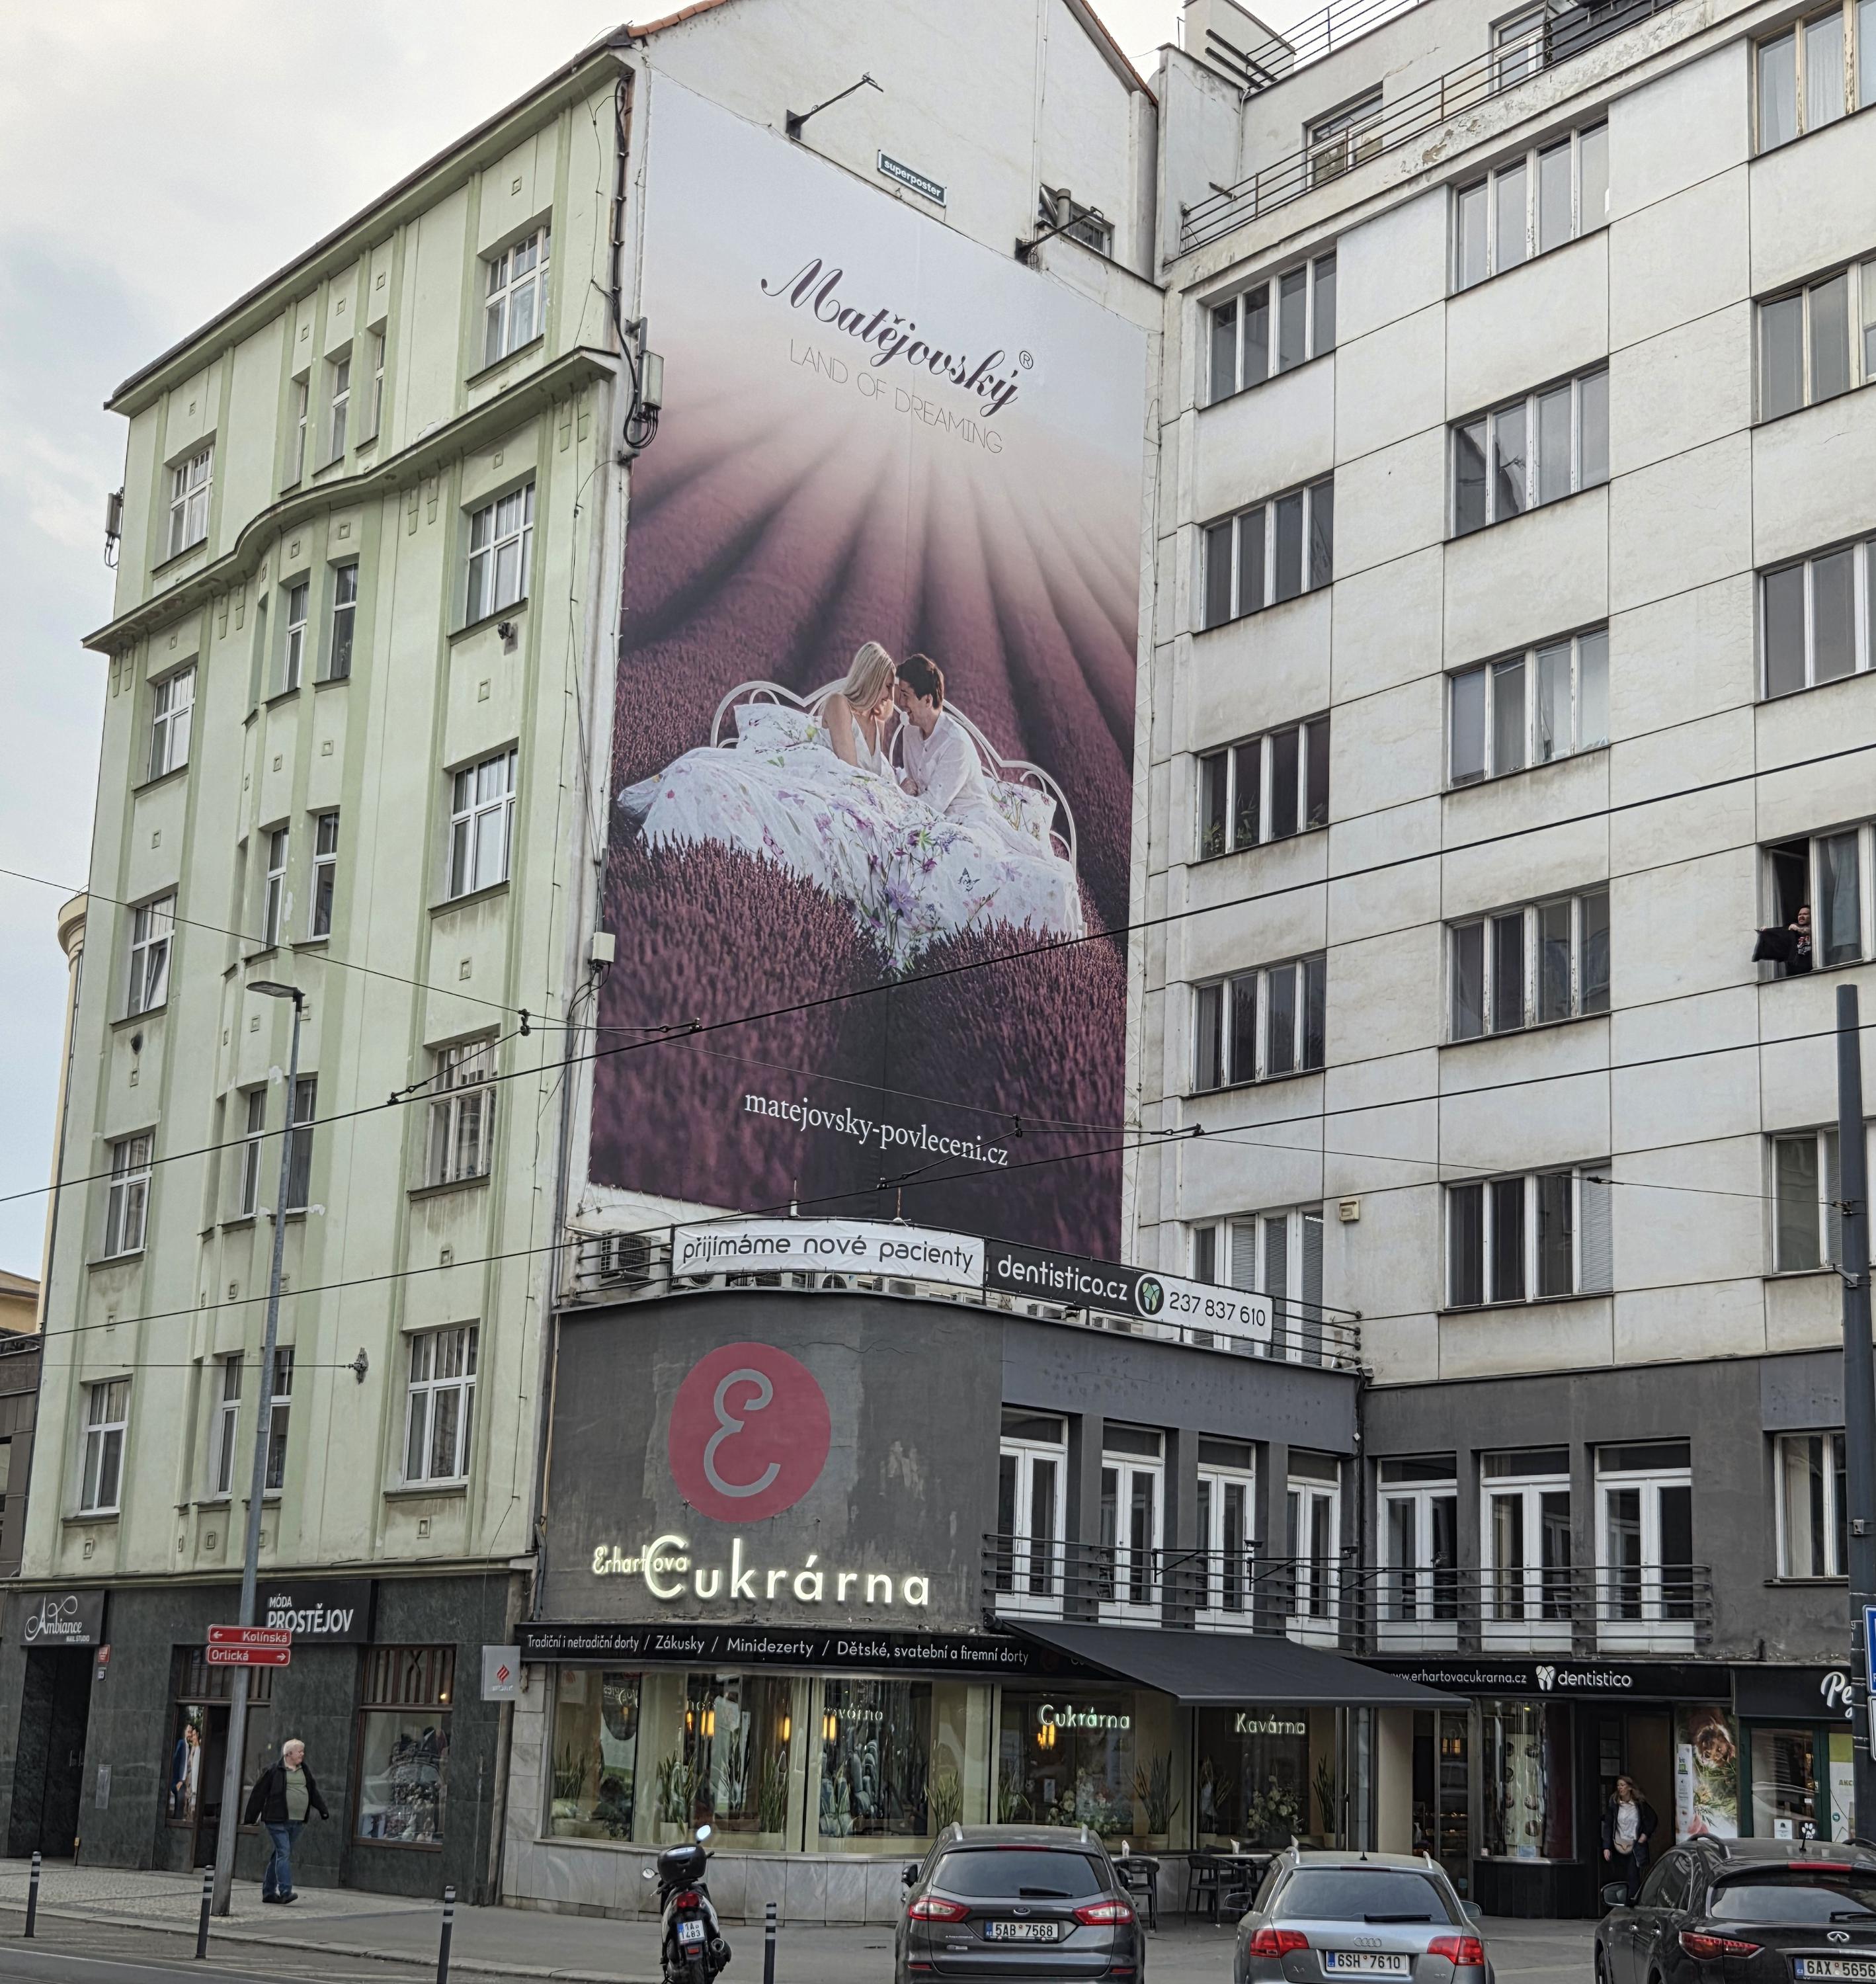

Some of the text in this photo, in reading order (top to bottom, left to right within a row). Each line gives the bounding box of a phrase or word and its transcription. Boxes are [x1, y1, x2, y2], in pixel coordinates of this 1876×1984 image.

[883, 159, 942, 197] superposter
[790, 339, 1002, 453] LAND OF DREAMING
[745, 1094, 1008, 1166] matejovsky-povleceni.cz
[683, 1233, 973, 1272] přijímáme nové pacienty
[998, 1255, 1127, 1301] dentistico.cz
[1169, 1292, 1266, 1327] 237 837 610
[644, 1535, 928, 1605] Cukrárna
[269, 1593, 292, 1608] MÓDA
[24, 1594, 83, 1641] Ambiance
[267, 1603, 354, 1632] PROSTĚJOV
[243, 1632, 287, 1643] Kolínská
[528, 1635, 561, 1647] Tradiční
[568, 1635, 612, 1647] netradiční
[615, 1635, 639, 1651] dorty
[655, 1635, 705, 1653] Zákusky
[727, 1637, 813, 1657] Minidezerty
[838, 1641, 890, 1659] Dětské,
[894, 1643, 948, 1659] svatební
[950, 1650, 958, 1659] a
[961, 1645, 997, 1661] firemní
[1000, 1647, 1028, 1666] dorty
[212, 1650, 249, 1661] Orlická
[1558, 1670, 1632, 1686] dentistico
[1820, 1671, 1852, 1719] Pe
[1038, 1705, 1130, 1729] Cukrárna
[1235, 1713, 1305, 1735] Kavárna
[995, 1923, 1016, 1936] 5AB
[1026, 1924, 1053, 1936] 7568
[1337, 1954, 1400, 1969] 6SH 7610
[1807, 1960, 1876, 1977] 6AX 5656
